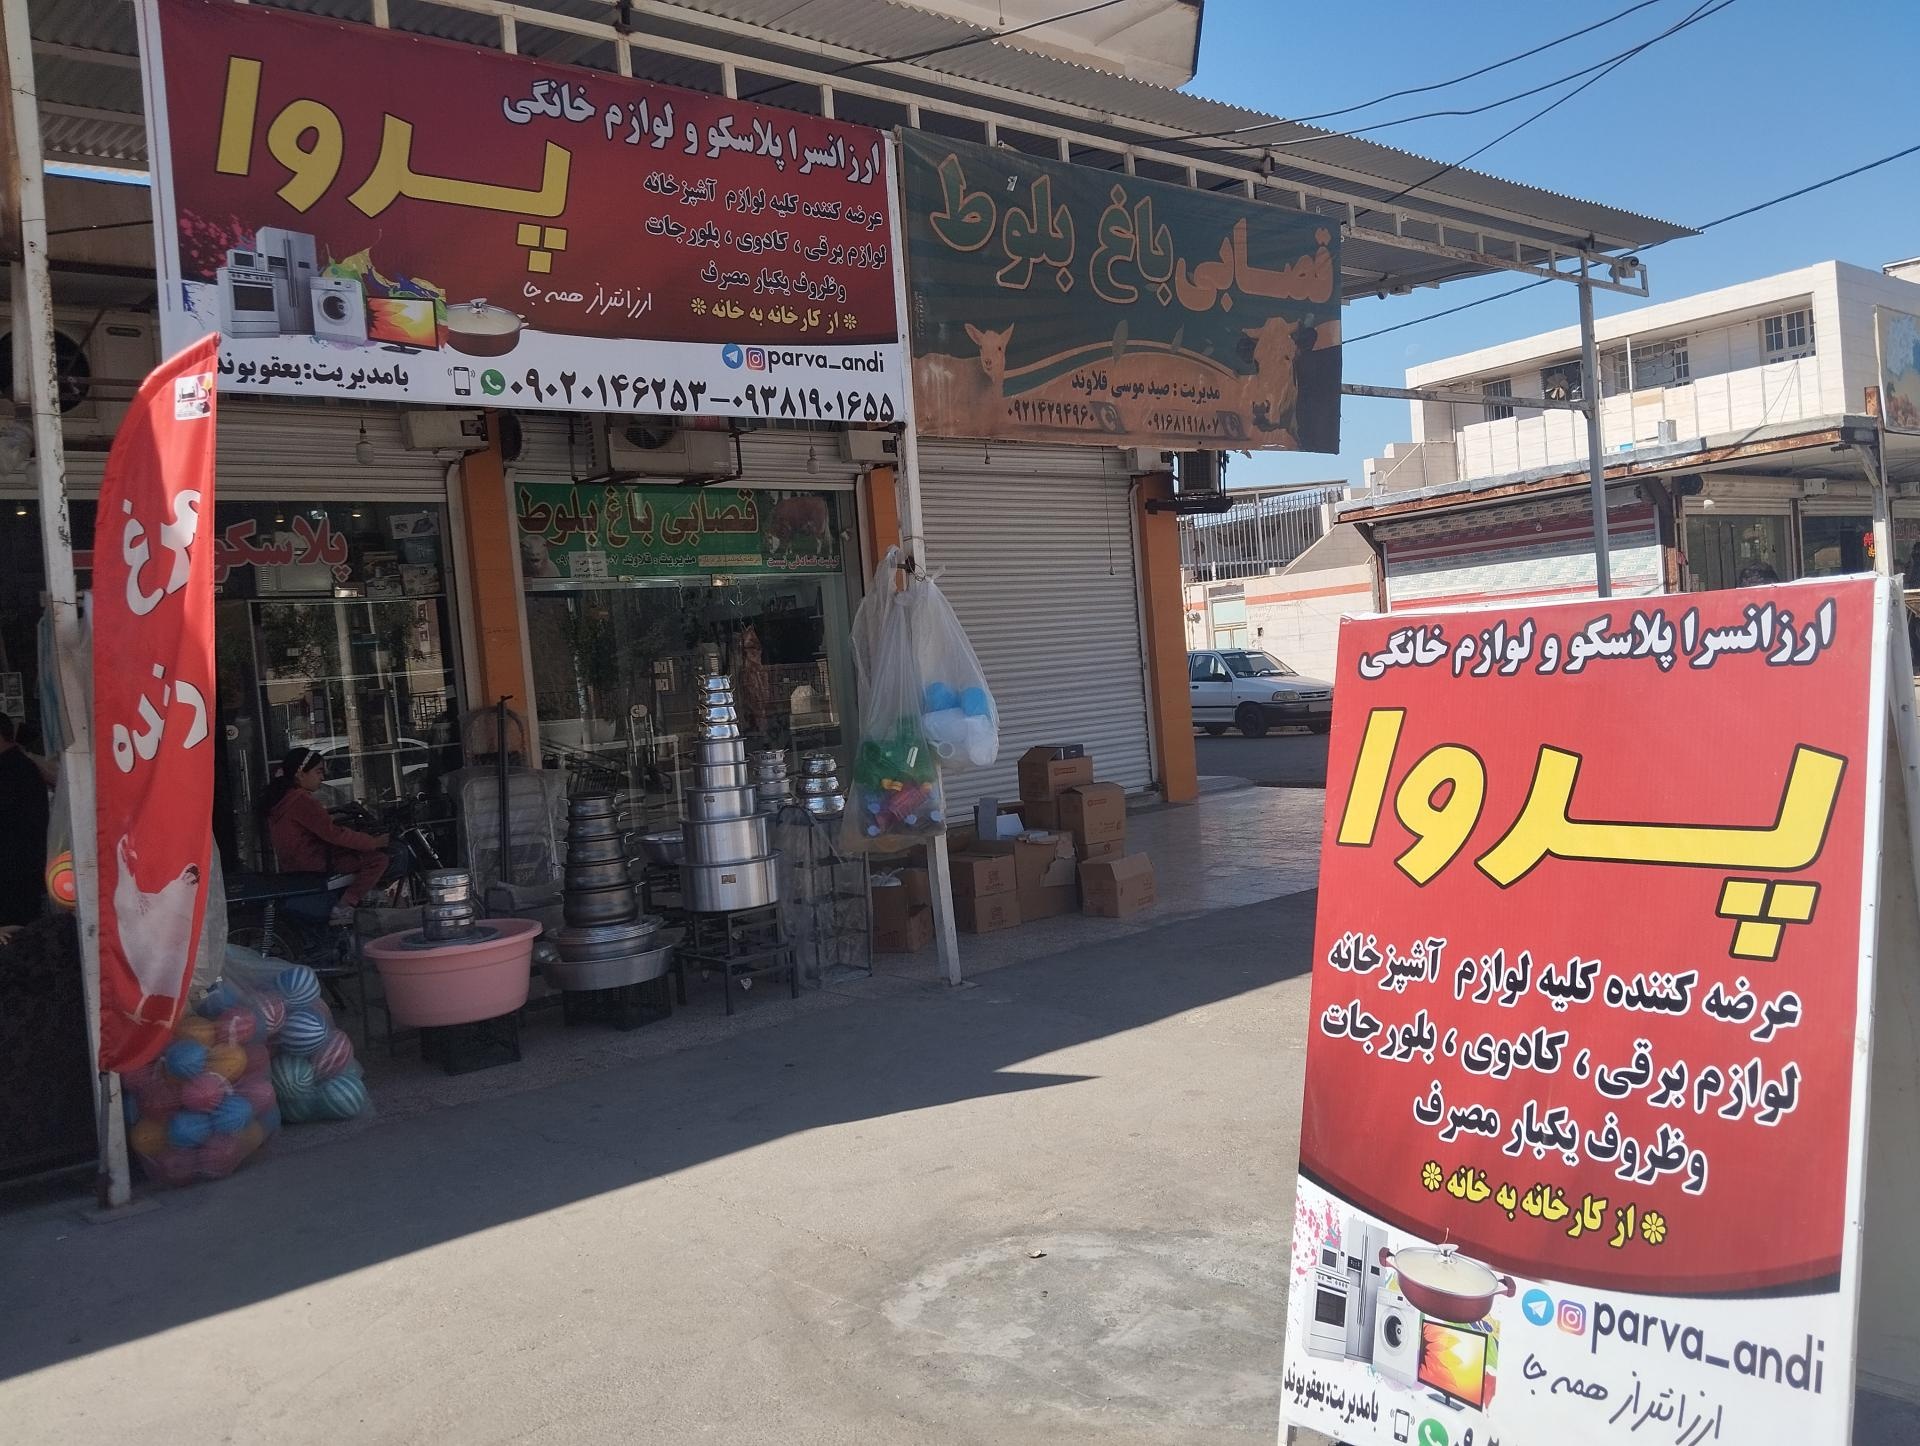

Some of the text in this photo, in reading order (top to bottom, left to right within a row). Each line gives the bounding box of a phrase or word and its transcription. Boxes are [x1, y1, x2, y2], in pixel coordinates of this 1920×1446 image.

[502, 79, 882, 185] ارزانسرا پلاسکو و لوازم خانگی
[216, 55, 572, 274] پروا
[643, 172, 883, 232] عرضه کننده کلیه لوازم آشپزخانه
[644, 214, 720, 247] بلورجات
[736, 228, 790, 256] کادوی
[805, 234, 844, 266] برقی
[847, 241, 888, 270] لوازم
[929, 152, 1333, 313] قصابی باغ بلوط
[523, 281, 542, 306] جا
[544, 291, 584, 303] همه
[699, 260, 749, 291] مصرف
[755, 269, 789, 294] یکبار
[711, 302, 839, 334] از کارخانه به خانه
[767, 346, 885, 374] parva_andi
[1072, 369, 1108, 396] قلاوند
[1111, 384, 1145, 400] موسی
[1180, 383, 1220, 404] مدیریت
[517, 484, 760, 549] قصابی باغ بلوط
[123, 489, 202, 616] مرغ
[1358, 596, 1837, 680] ارزانسرا پلاسکو و لوازم خانگی
[1336, 706, 1849, 962] پروا
[1327, 929, 1803, 1042] عرضه کننده کلیه لوازم آشپزخانه
[1319, 998, 1437, 1065] بلورجات
[1461, 1025, 1569, 1080] کادوی
[1595, 1037, 1688, 1108] برقی
[1693, 1056, 1803, 1127] لوازم
[1412, 1079, 1501, 1144] مصرف
[1502, 1100, 1580, 1168] یکبار
[1446, 1164, 1636, 1249] از کارخانه به خانه
[1523, 1353, 1548, 1396] جا
[1590, 1298, 1826, 1395] parva_andi
[1550, 1376, 1609, 1401] همه
